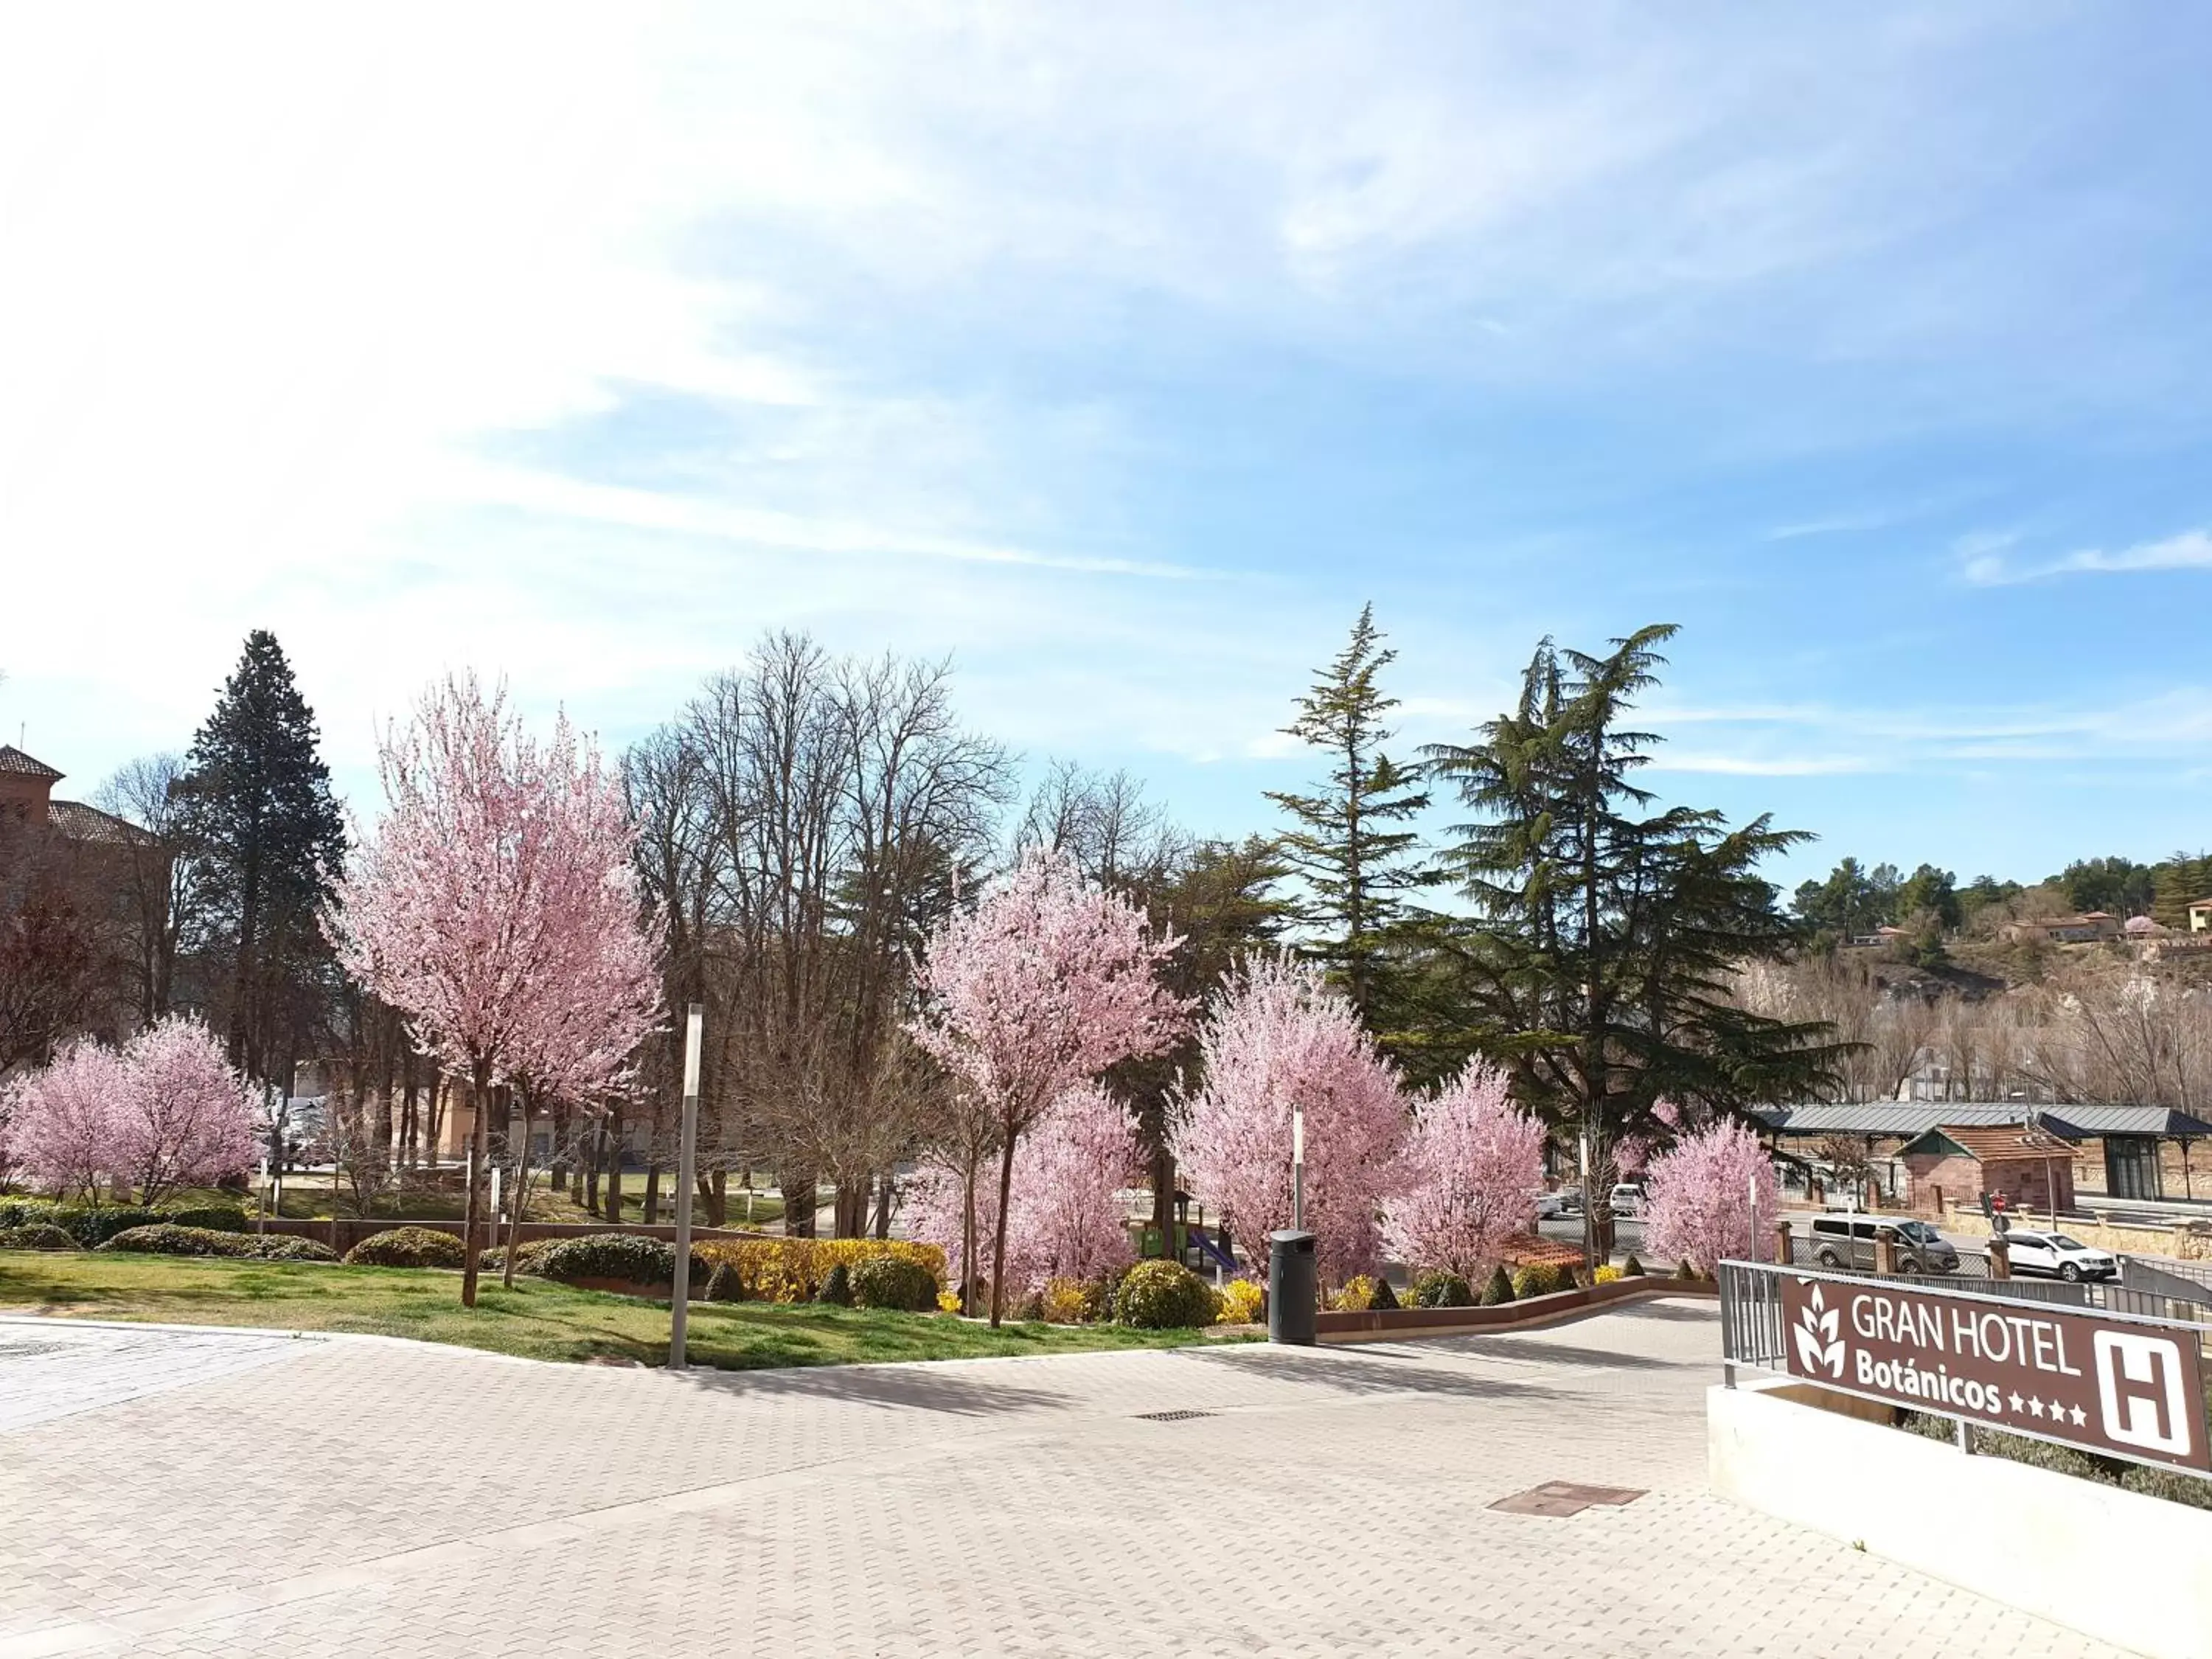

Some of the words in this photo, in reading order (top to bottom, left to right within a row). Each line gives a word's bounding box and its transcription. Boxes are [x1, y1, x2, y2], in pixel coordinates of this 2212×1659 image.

[1851, 1294, 1944, 1352] GRAN
[1952, 1307, 2082, 1377] HOTEL
[1855, 1348, 2003, 1414] Botánicos
[2110, 1344, 2173, 1440] H
